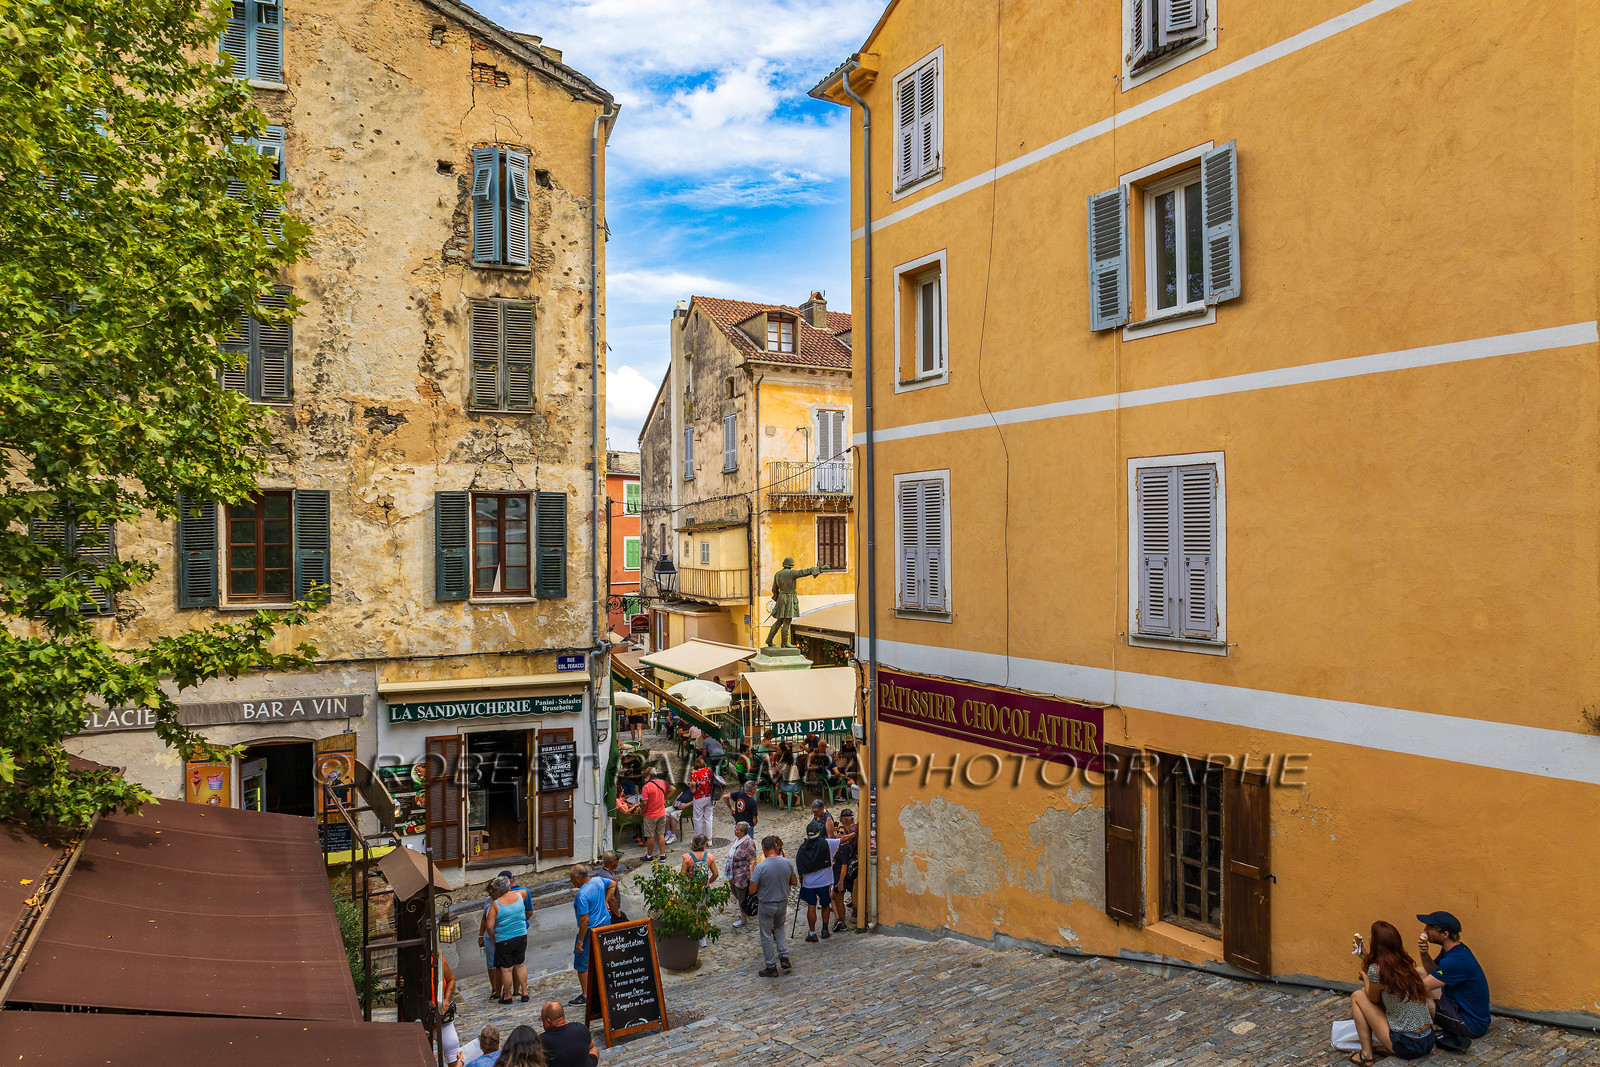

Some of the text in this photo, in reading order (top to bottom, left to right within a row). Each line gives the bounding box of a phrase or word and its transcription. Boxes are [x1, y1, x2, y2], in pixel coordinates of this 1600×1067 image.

[243, 698, 347, 719] BAR A VIN
[391, 700, 531, 721] LA SANDWICHERIE
[880, 679, 1099, 755] PÂTISSIER CHOCOLATIER
[777, 718, 847, 735] BAR DE LA
[603, 935, 625, 946] Assiette
[607, 944, 614, 952] de
[612, 971, 624, 979] Tarte
